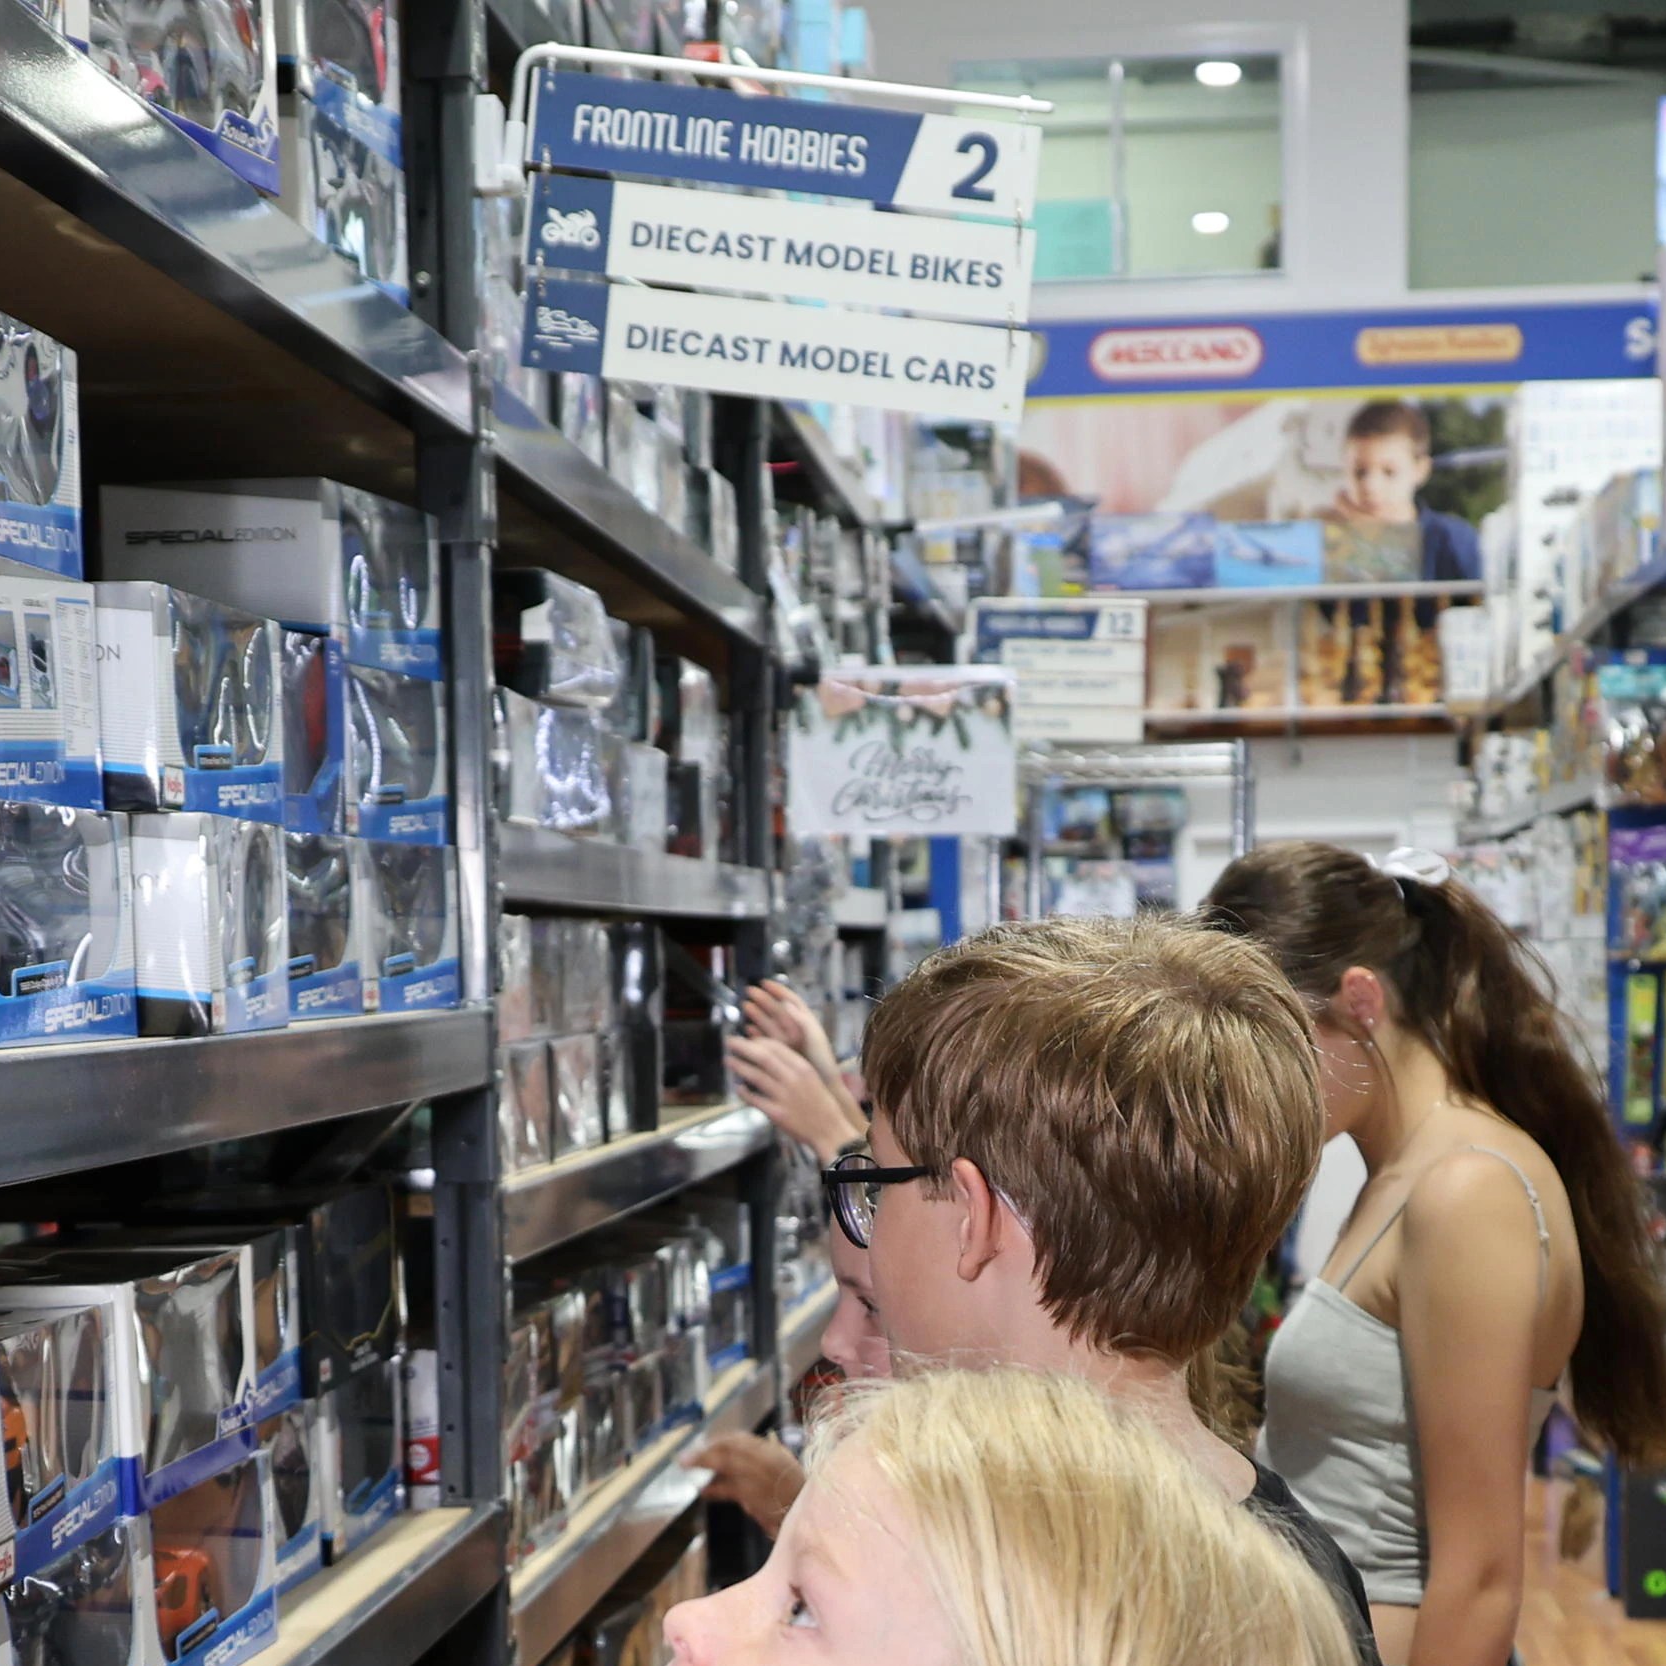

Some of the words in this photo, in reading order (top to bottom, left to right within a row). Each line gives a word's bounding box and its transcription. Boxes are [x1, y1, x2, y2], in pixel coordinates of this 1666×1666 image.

[572, 103, 733, 160] FRONTLINE
[740, 122, 868, 177] HOBBIES
[951, 131, 999, 202] 2
[630, 220, 776, 263] DIECAST
[783, 240, 899, 278] MODEL
[910, 254, 1004, 290] BIKES
[626, 322, 770, 365] DIECAST
[778, 342, 895, 379] MODEL
[905, 355, 997, 390] CARS
[849, 742, 964, 781] Merry
[832, 772, 973, 824] Christmas
